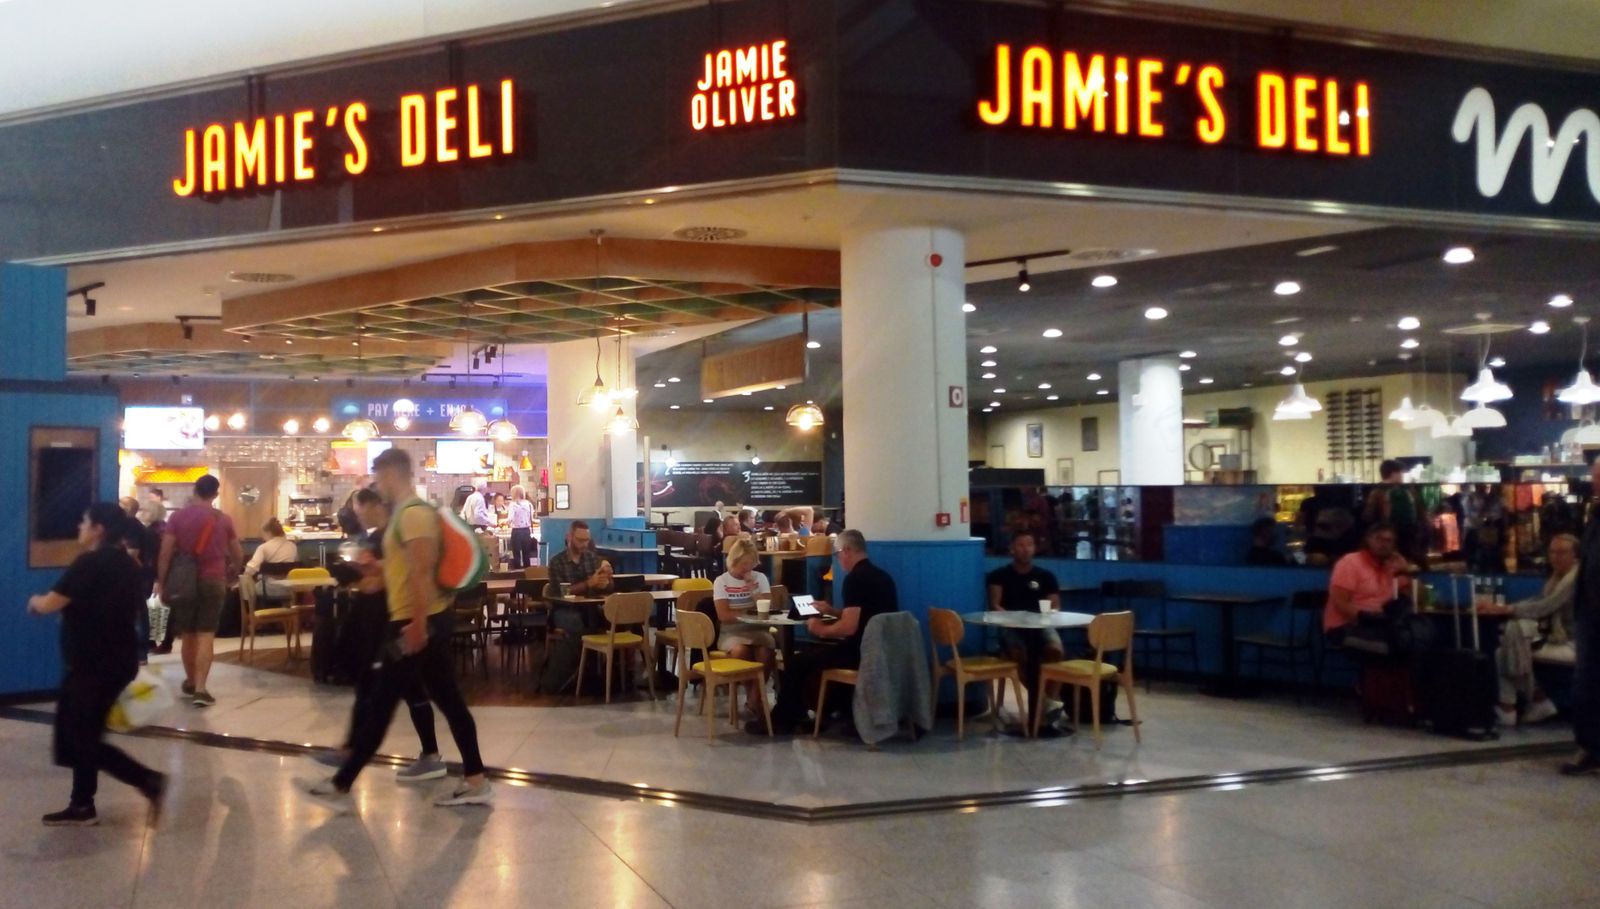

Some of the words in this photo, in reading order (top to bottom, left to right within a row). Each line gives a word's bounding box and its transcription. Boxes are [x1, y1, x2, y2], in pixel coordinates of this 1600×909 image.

[696, 40, 787, 91] JAMIE
[691, 79, 796, 131] OLIVER
[978, 43, 1226, 143] JAMIE'S
[1257, 72, 1371, 156] DELI
[172, 102, 368, 197] JAMIE'S
[400, 79, 514, 168] DELI
[367, 403, 389, 417] PAY
